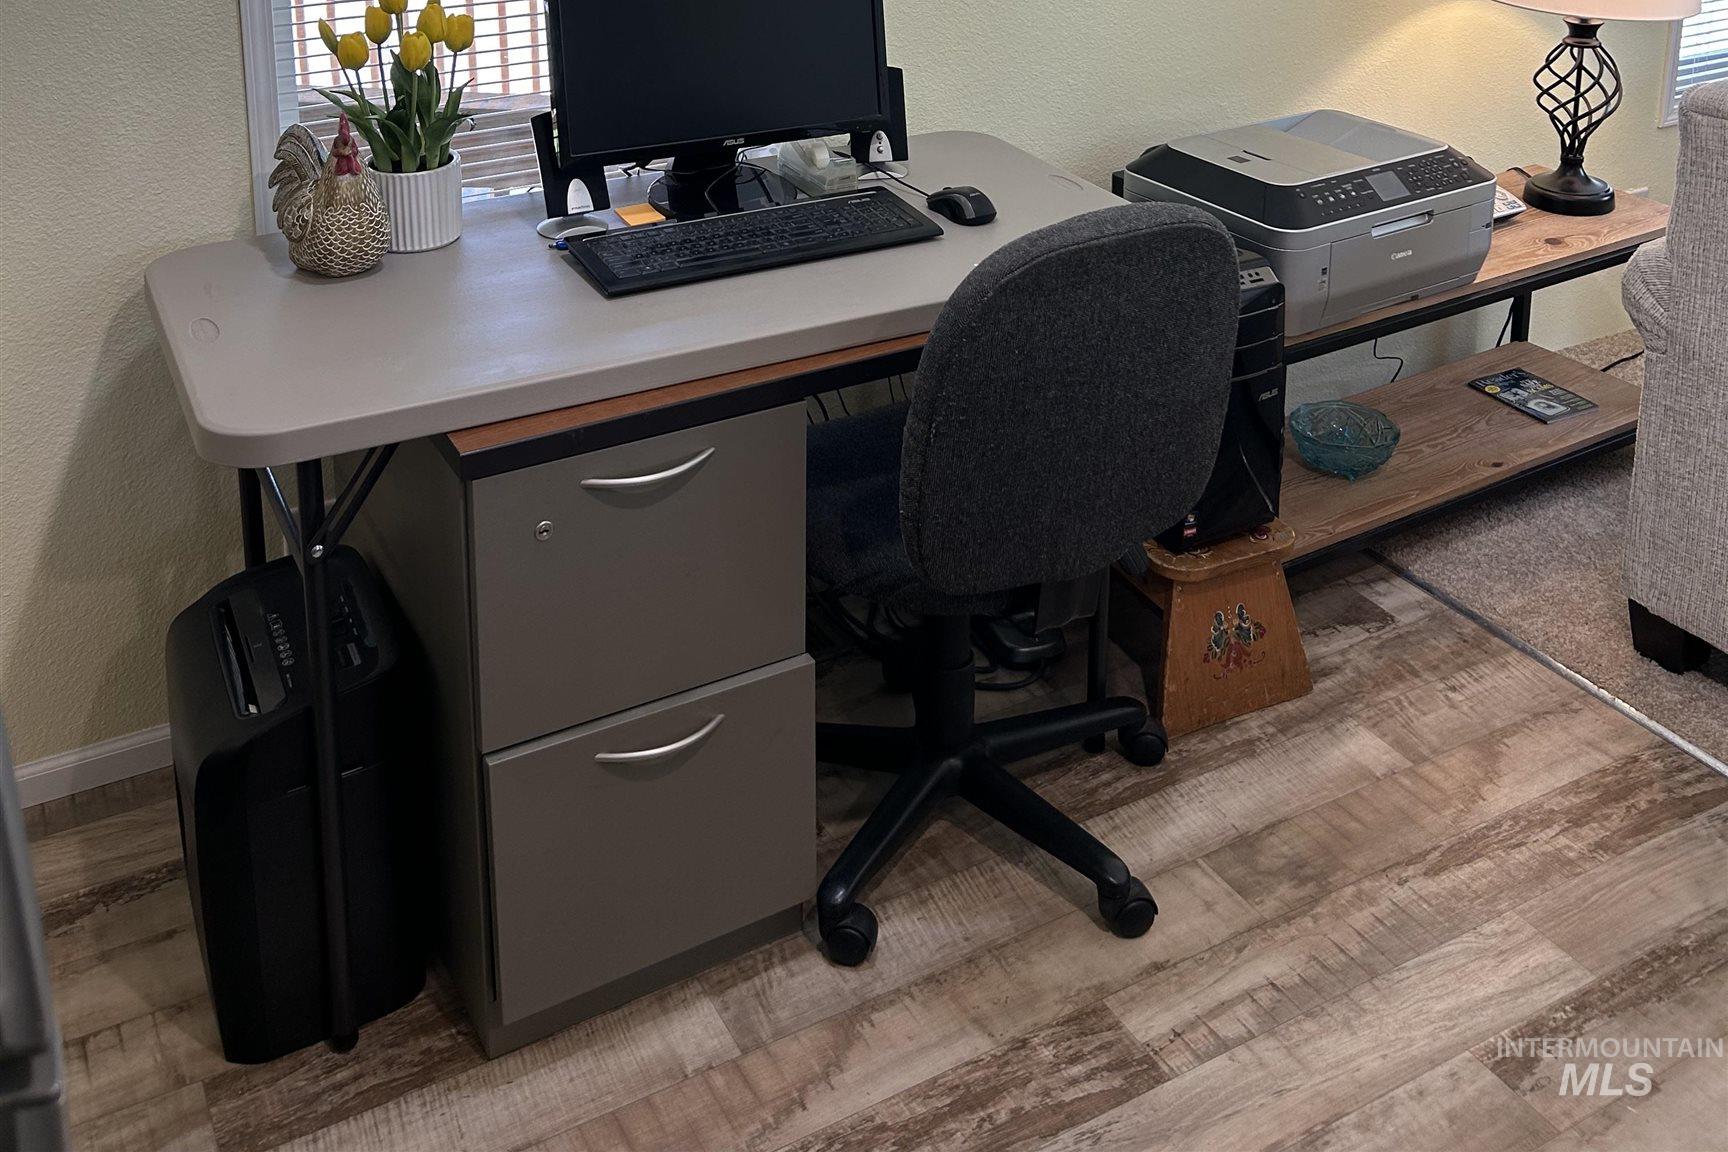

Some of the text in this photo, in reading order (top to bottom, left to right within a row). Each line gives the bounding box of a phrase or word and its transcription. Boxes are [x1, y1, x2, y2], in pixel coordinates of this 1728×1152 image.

[723, 138, 745, 146] ASUS
[1390, 249, 1412, 260] Canon
[1258, 388, 1279, 401] ASUS
